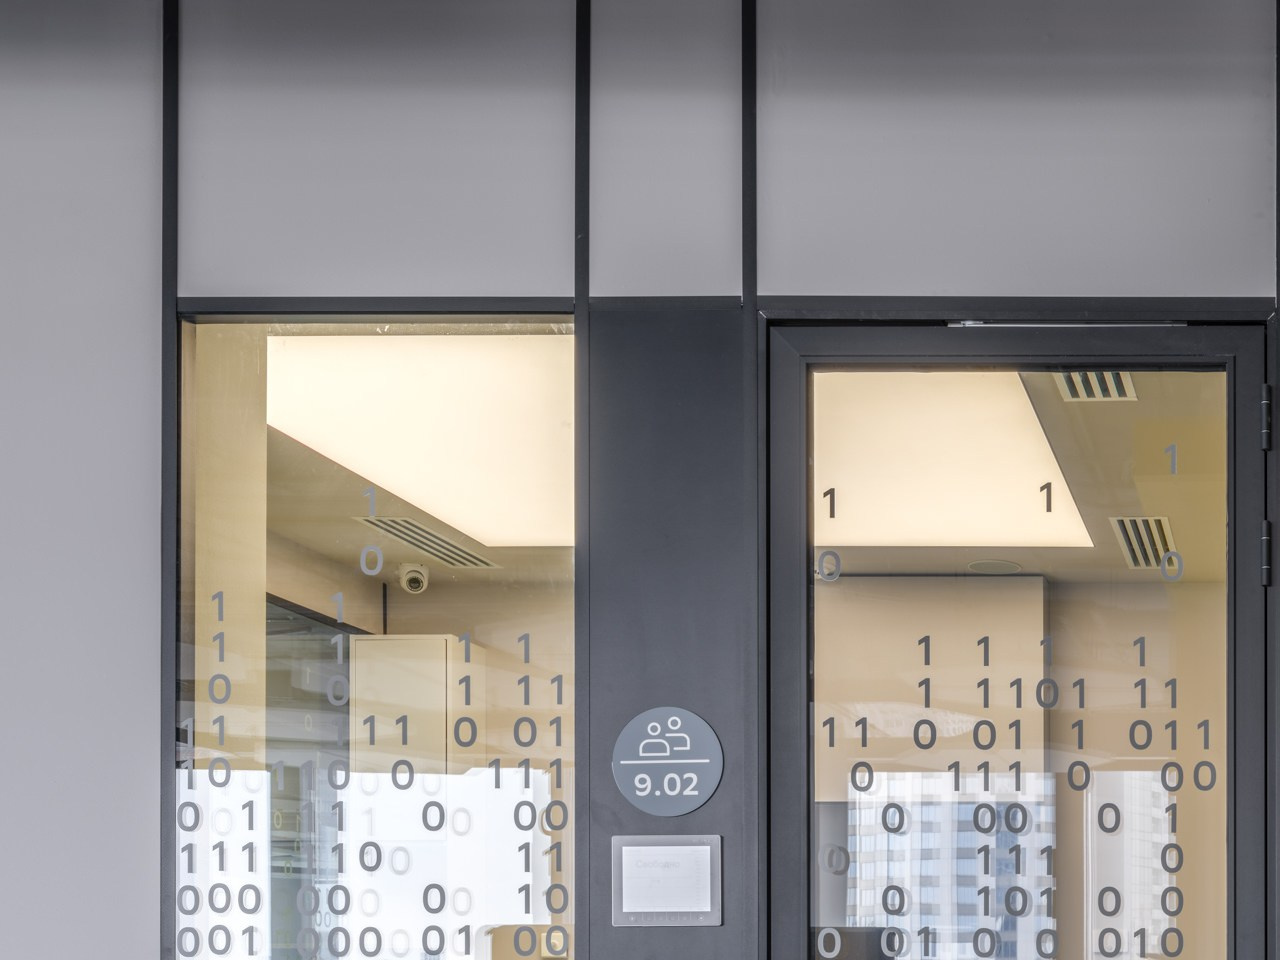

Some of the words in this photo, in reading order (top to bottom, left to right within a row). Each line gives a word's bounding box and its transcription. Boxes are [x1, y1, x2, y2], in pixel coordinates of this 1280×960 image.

[1164, 444, 1178, 475] 1
[363, 487, 375, 516] 1
[360, 546, 384, 576] 0
[634, 772, 699, 796] 9.02
